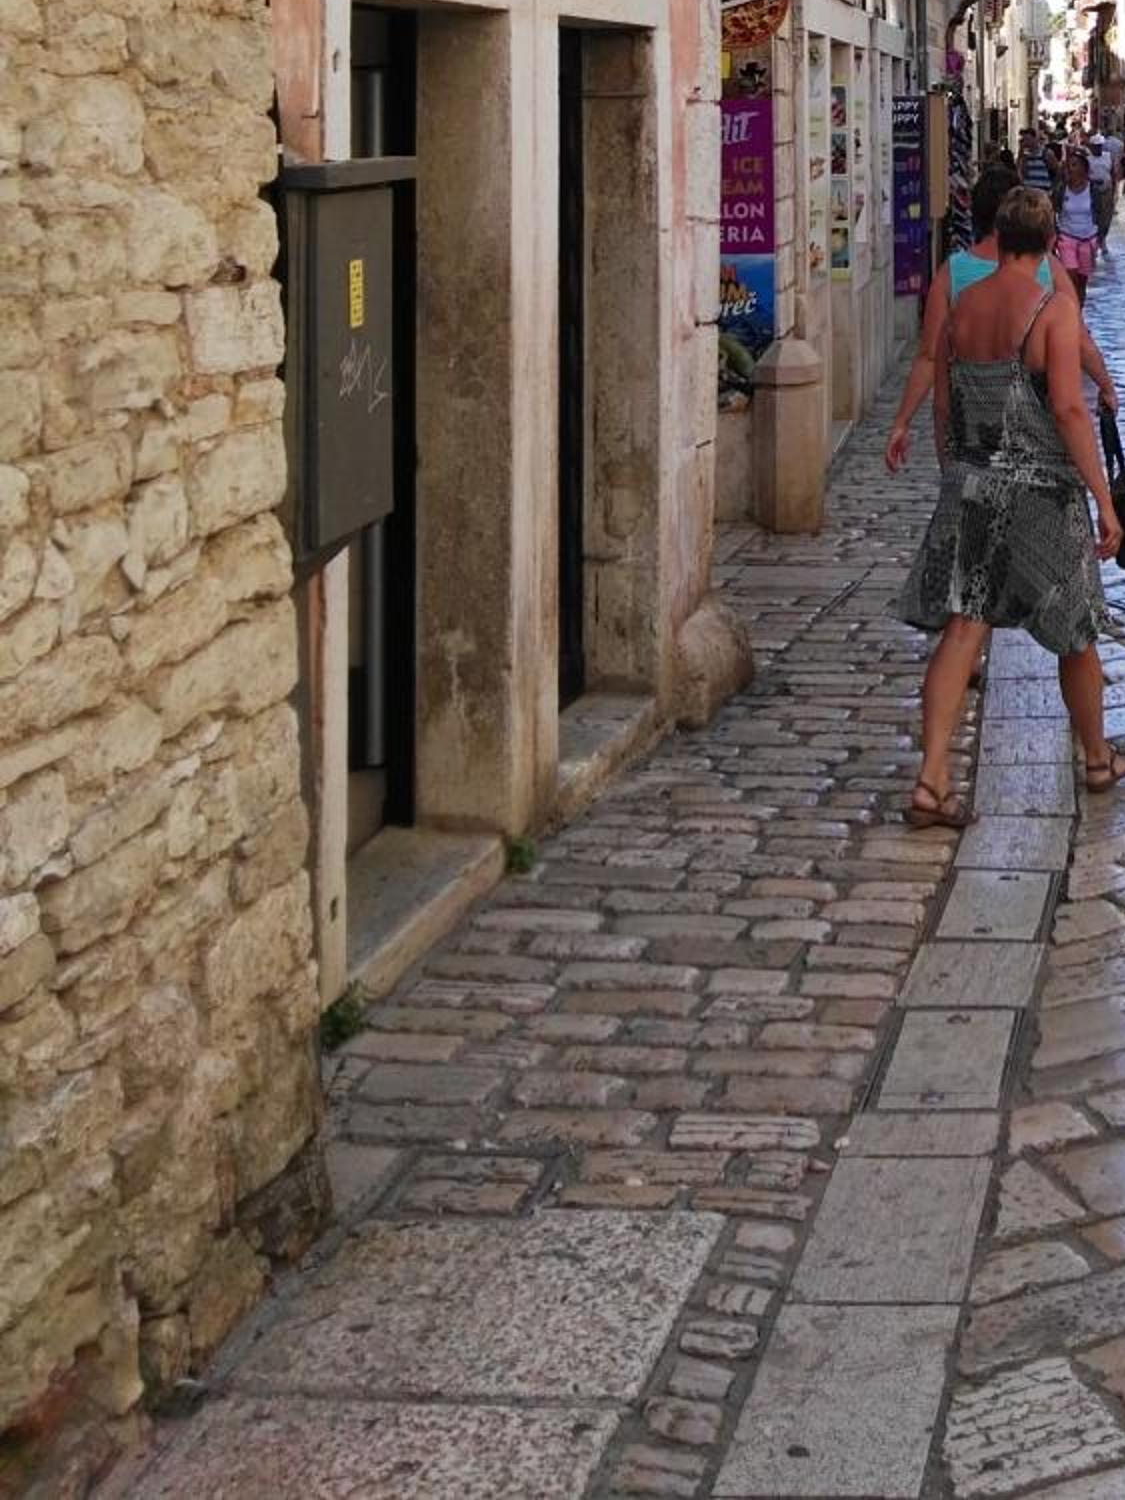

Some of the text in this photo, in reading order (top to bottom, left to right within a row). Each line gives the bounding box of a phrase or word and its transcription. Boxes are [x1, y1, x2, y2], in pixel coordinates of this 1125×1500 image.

[733, 156, 766, 174] ICE
[722, 179, 765, 196] EAM
[722, 202, 765, 220] LON
